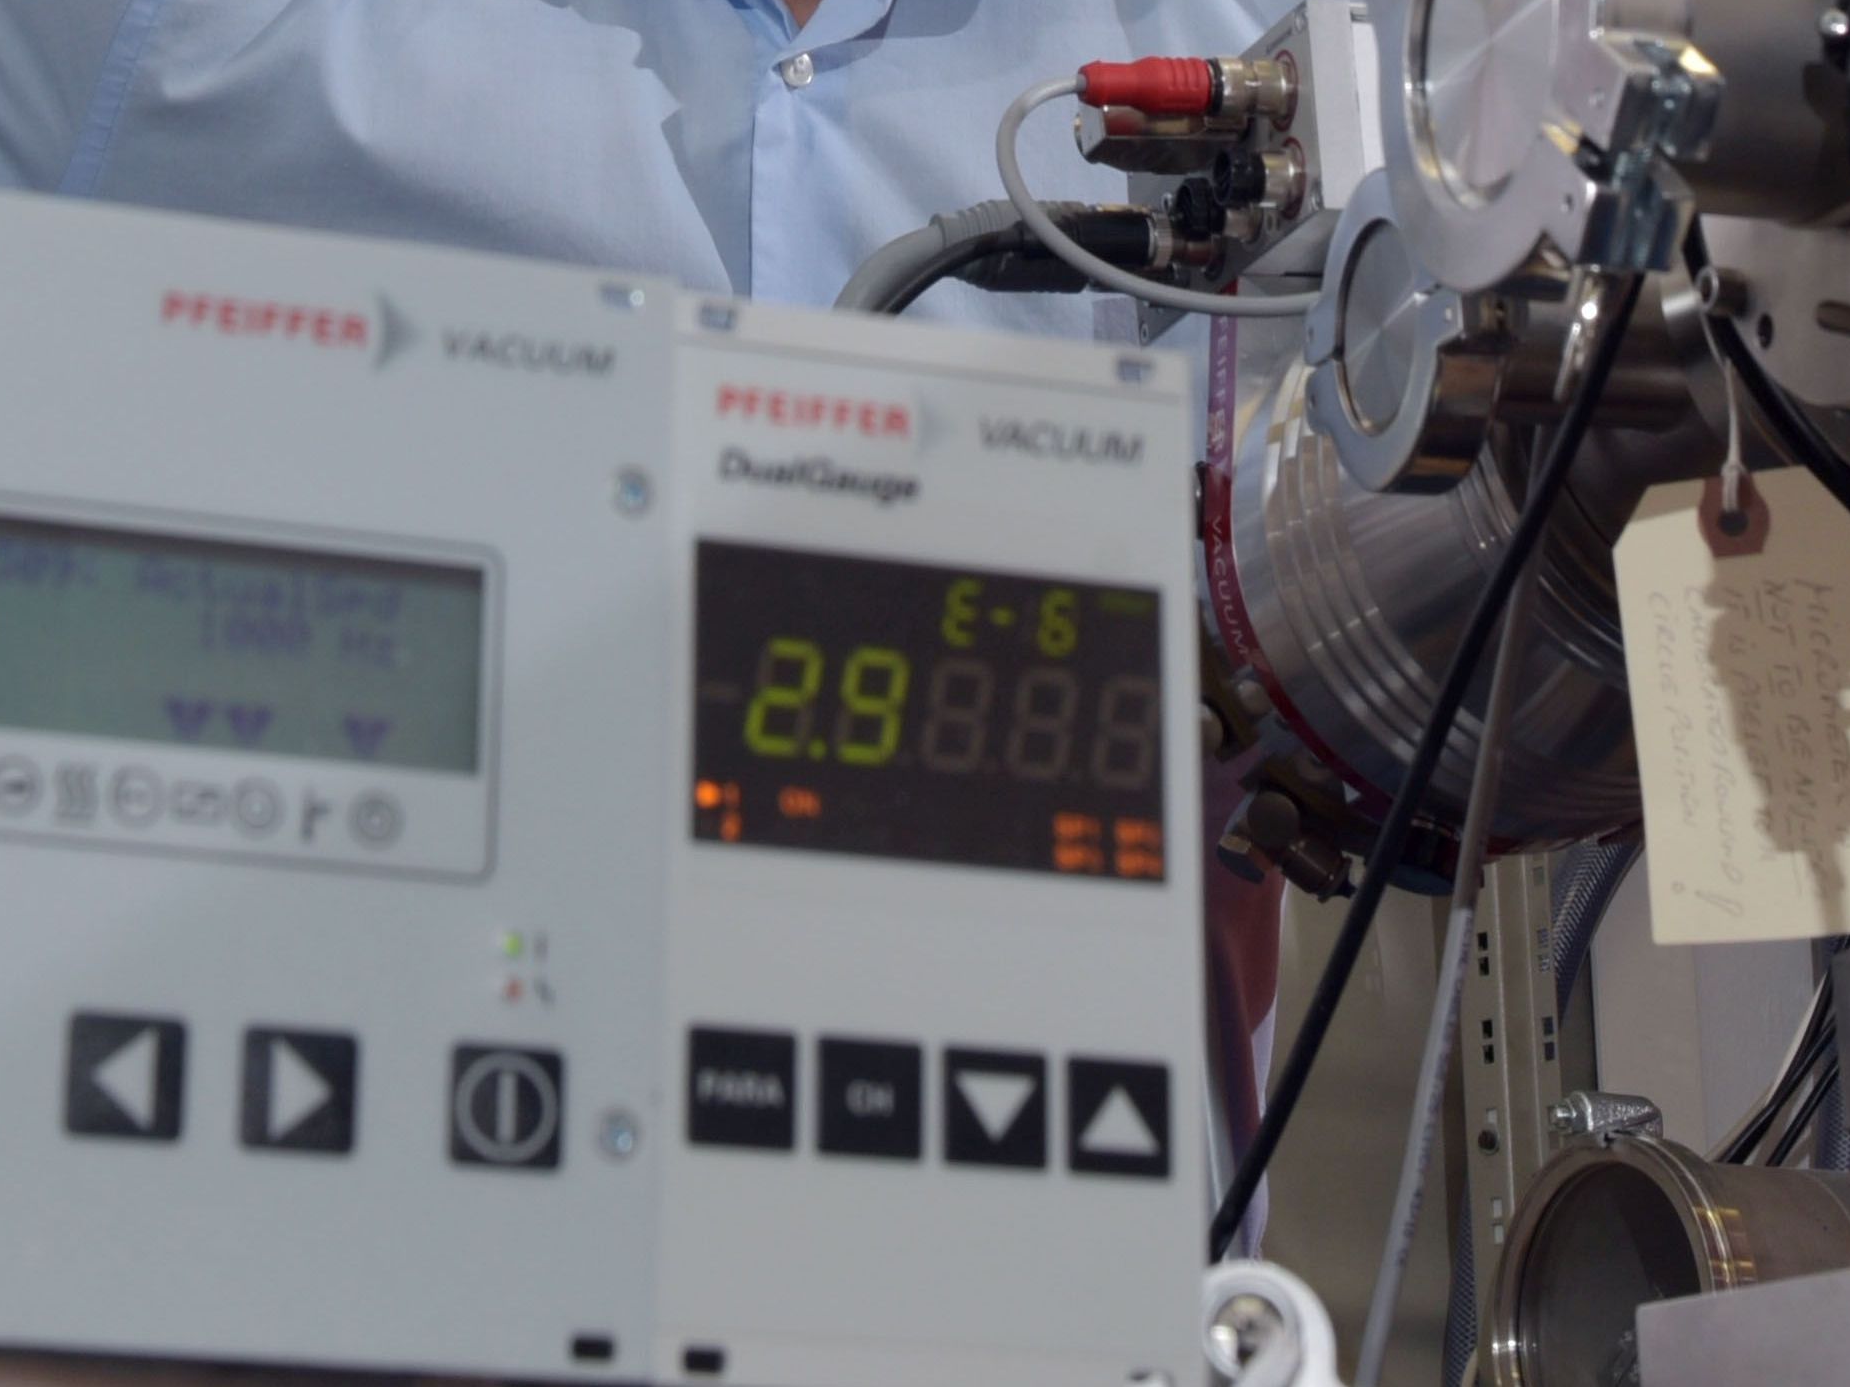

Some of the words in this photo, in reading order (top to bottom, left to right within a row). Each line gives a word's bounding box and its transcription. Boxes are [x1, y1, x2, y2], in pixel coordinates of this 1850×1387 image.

[161, 288, 370, 350] PFEIFFER
[441, 327, 619, 381] VACUUM
[717, 383, 912, 441] PFEIFFER
[978, 415, 1145, 466] VACUUM
[717, 447, 920, 507] DualGauge
[1210, 514, 1248, 656] VACUUM
[1761, 580, 1798, 647] NOT
[742, 637, 912, 766] 2.9
[696, 1068, 785, 1111] PARA
[846, 1079, 895, 1119] CH
